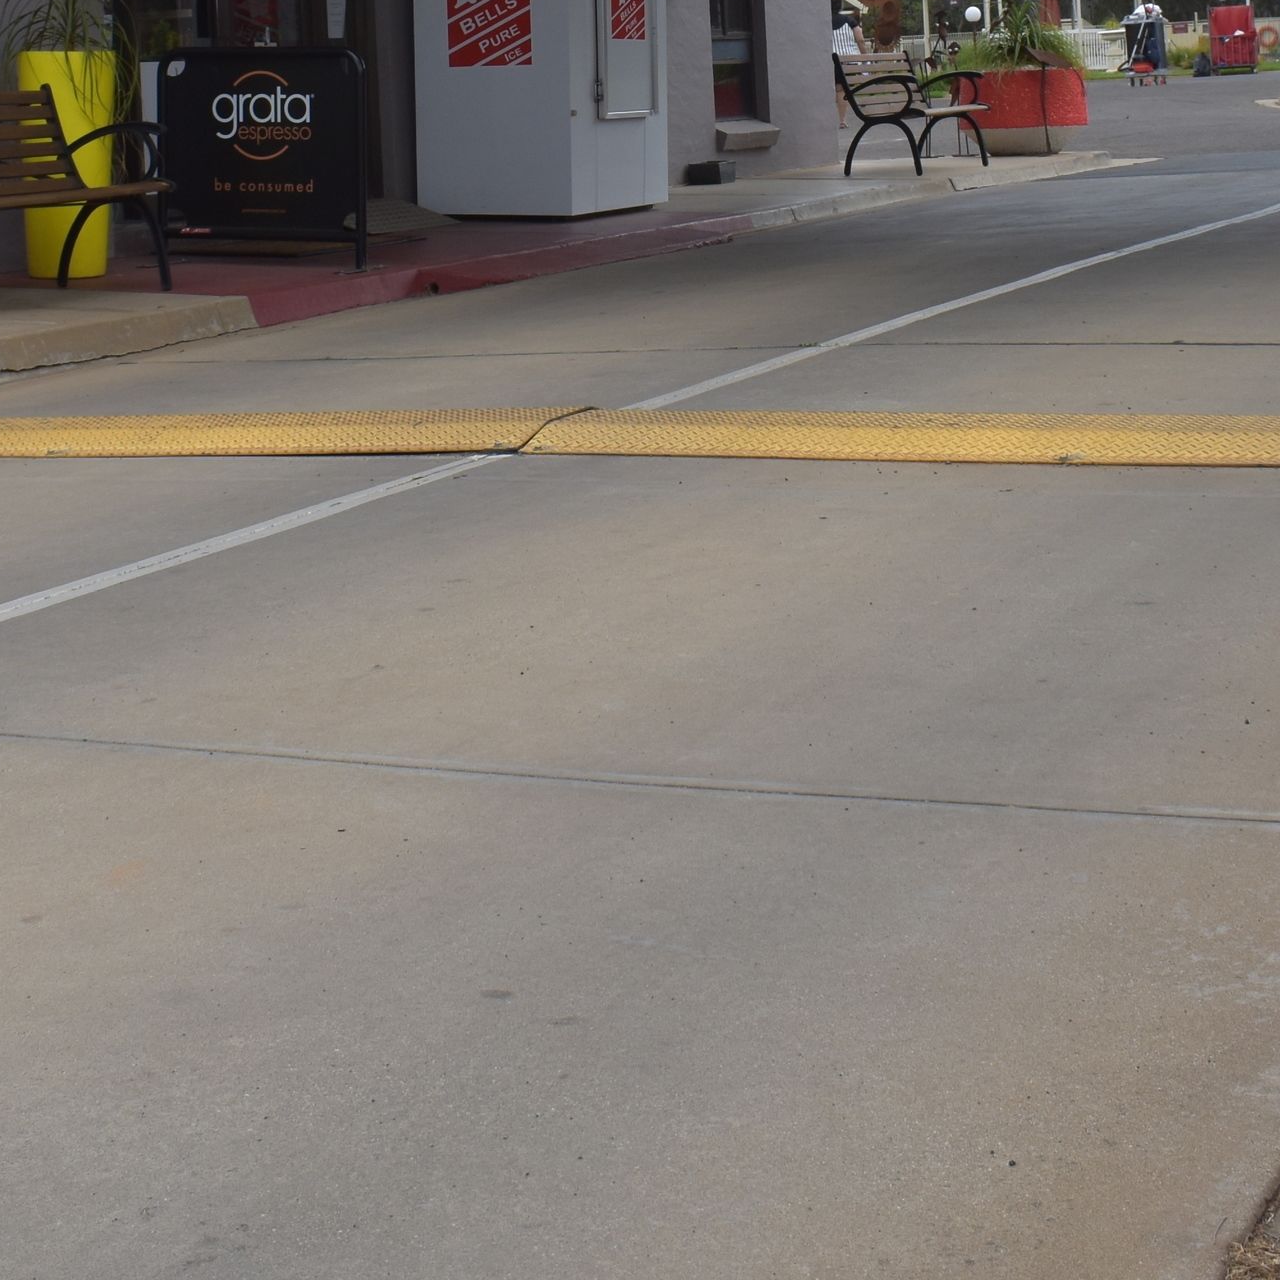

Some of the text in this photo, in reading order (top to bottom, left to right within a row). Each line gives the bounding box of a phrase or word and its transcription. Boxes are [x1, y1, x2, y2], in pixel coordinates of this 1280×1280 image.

[478, 24, 521, 53] PURE
[504, 47, 523, 62] ICE
[212, 86, 311, 139] grata
[238, 125, 312, 145] espresso
[214, 177, 314, 192] be consumed
